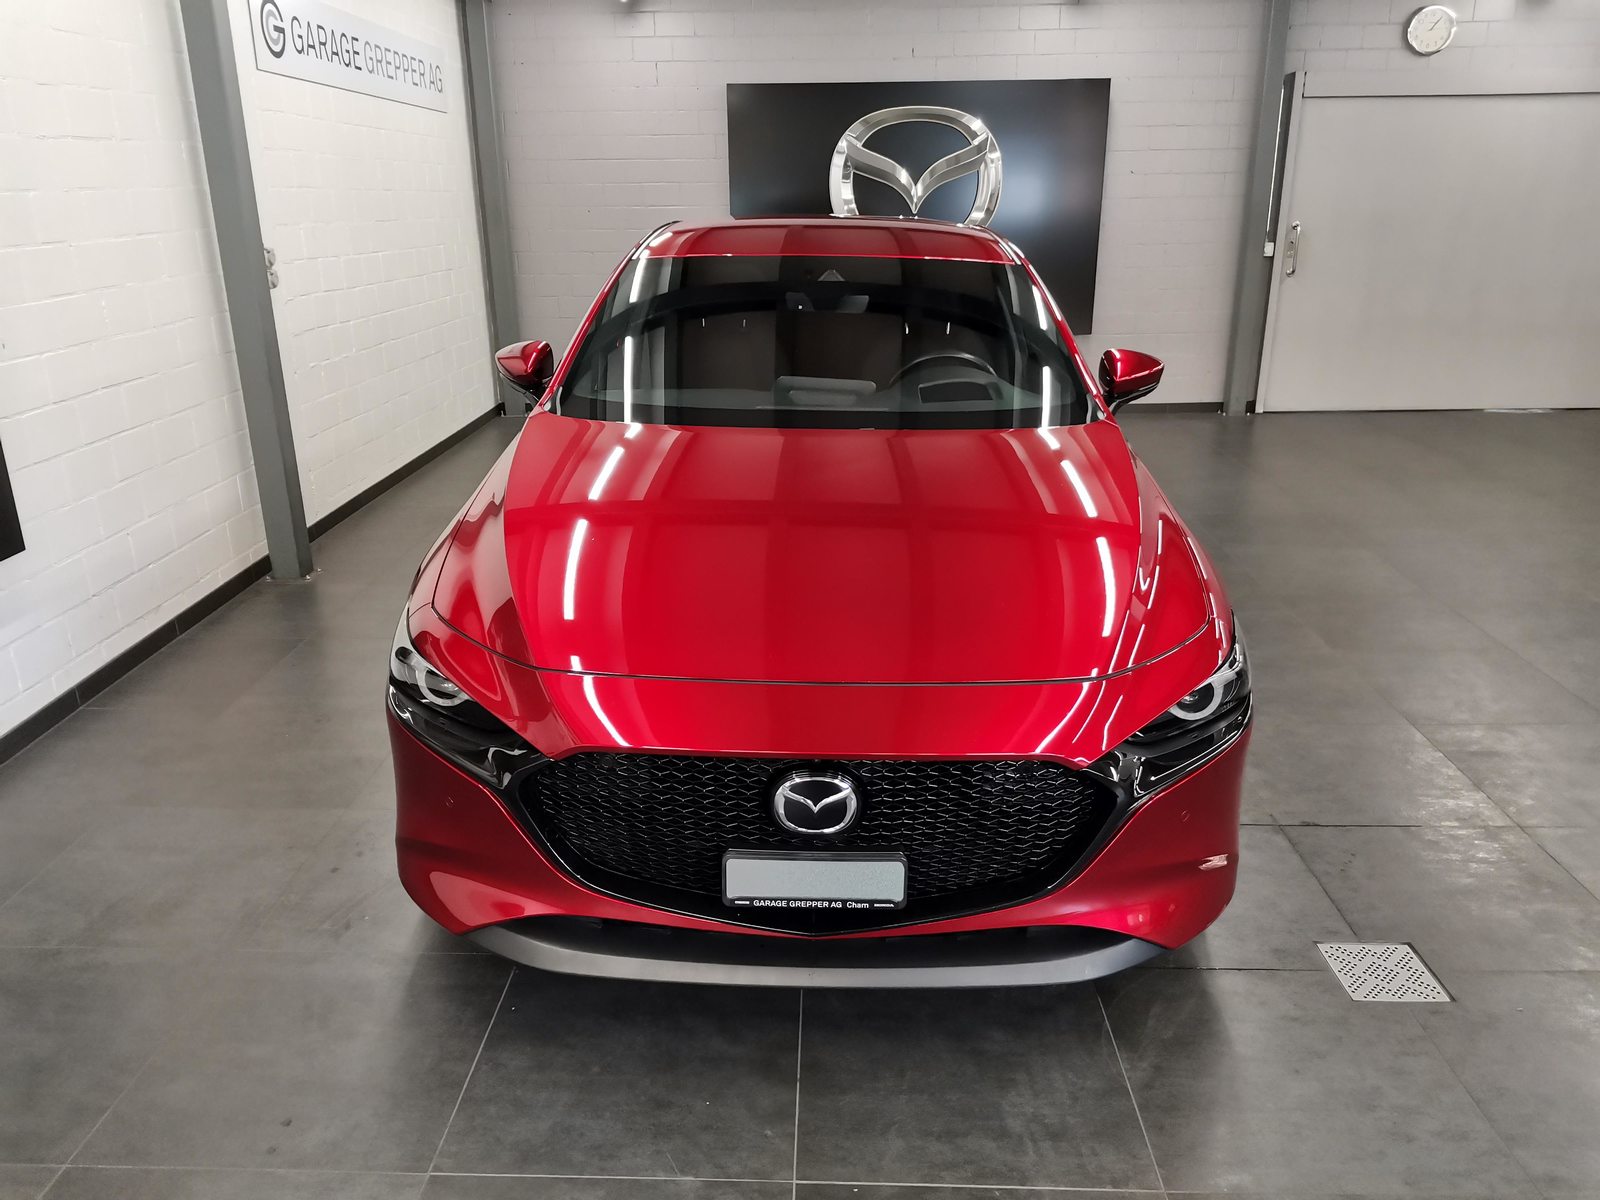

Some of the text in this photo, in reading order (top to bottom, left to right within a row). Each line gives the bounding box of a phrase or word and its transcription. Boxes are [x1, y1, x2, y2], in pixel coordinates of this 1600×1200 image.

[290, 15, 443, 94] GARAGE GREPPER AG
[753, 899, 787, 907] GARAGE
[789, 900, 829, 908] GREPPER
[846, 901, 869, 909] Cham
